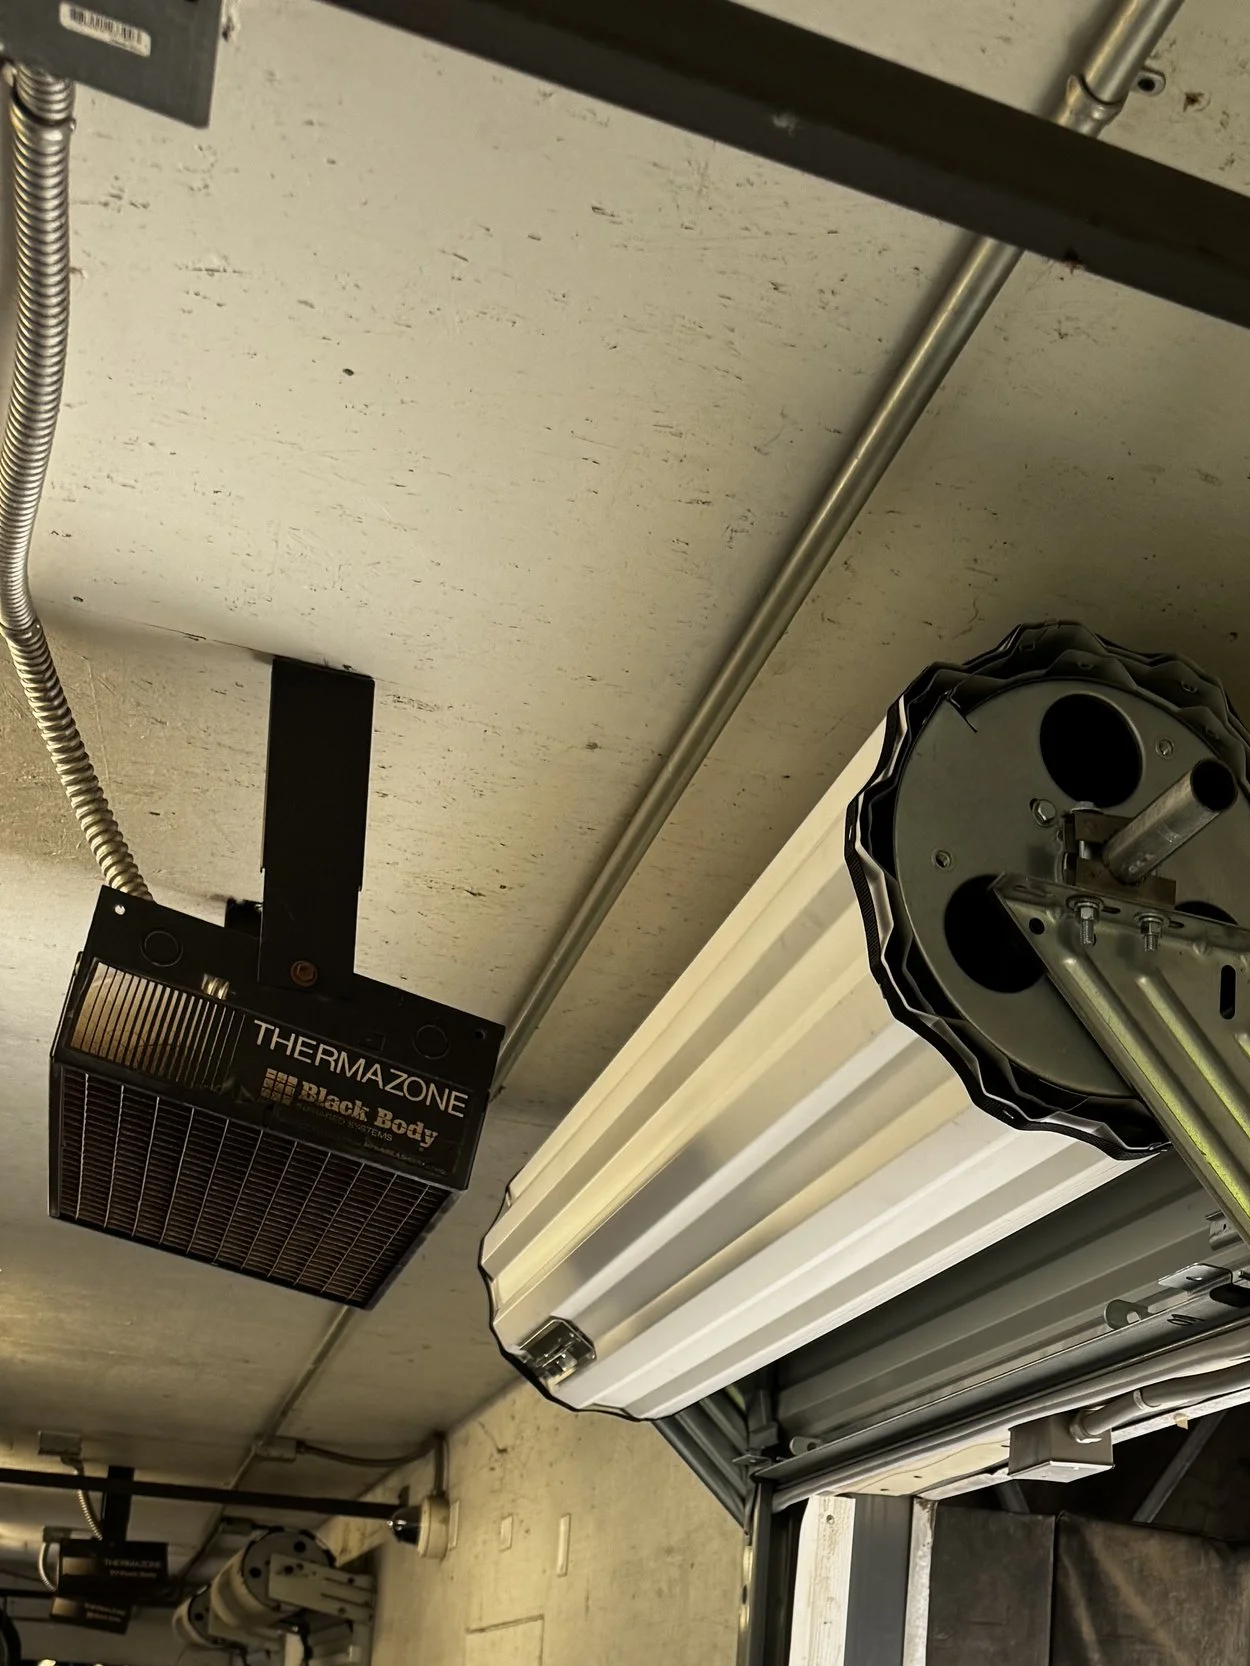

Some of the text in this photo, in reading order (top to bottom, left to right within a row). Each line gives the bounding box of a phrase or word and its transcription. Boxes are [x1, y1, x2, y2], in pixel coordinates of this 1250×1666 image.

[253, 1019, 469, 1118] THERMAZONE
[297, 1080, 439, 1149] Black Body
